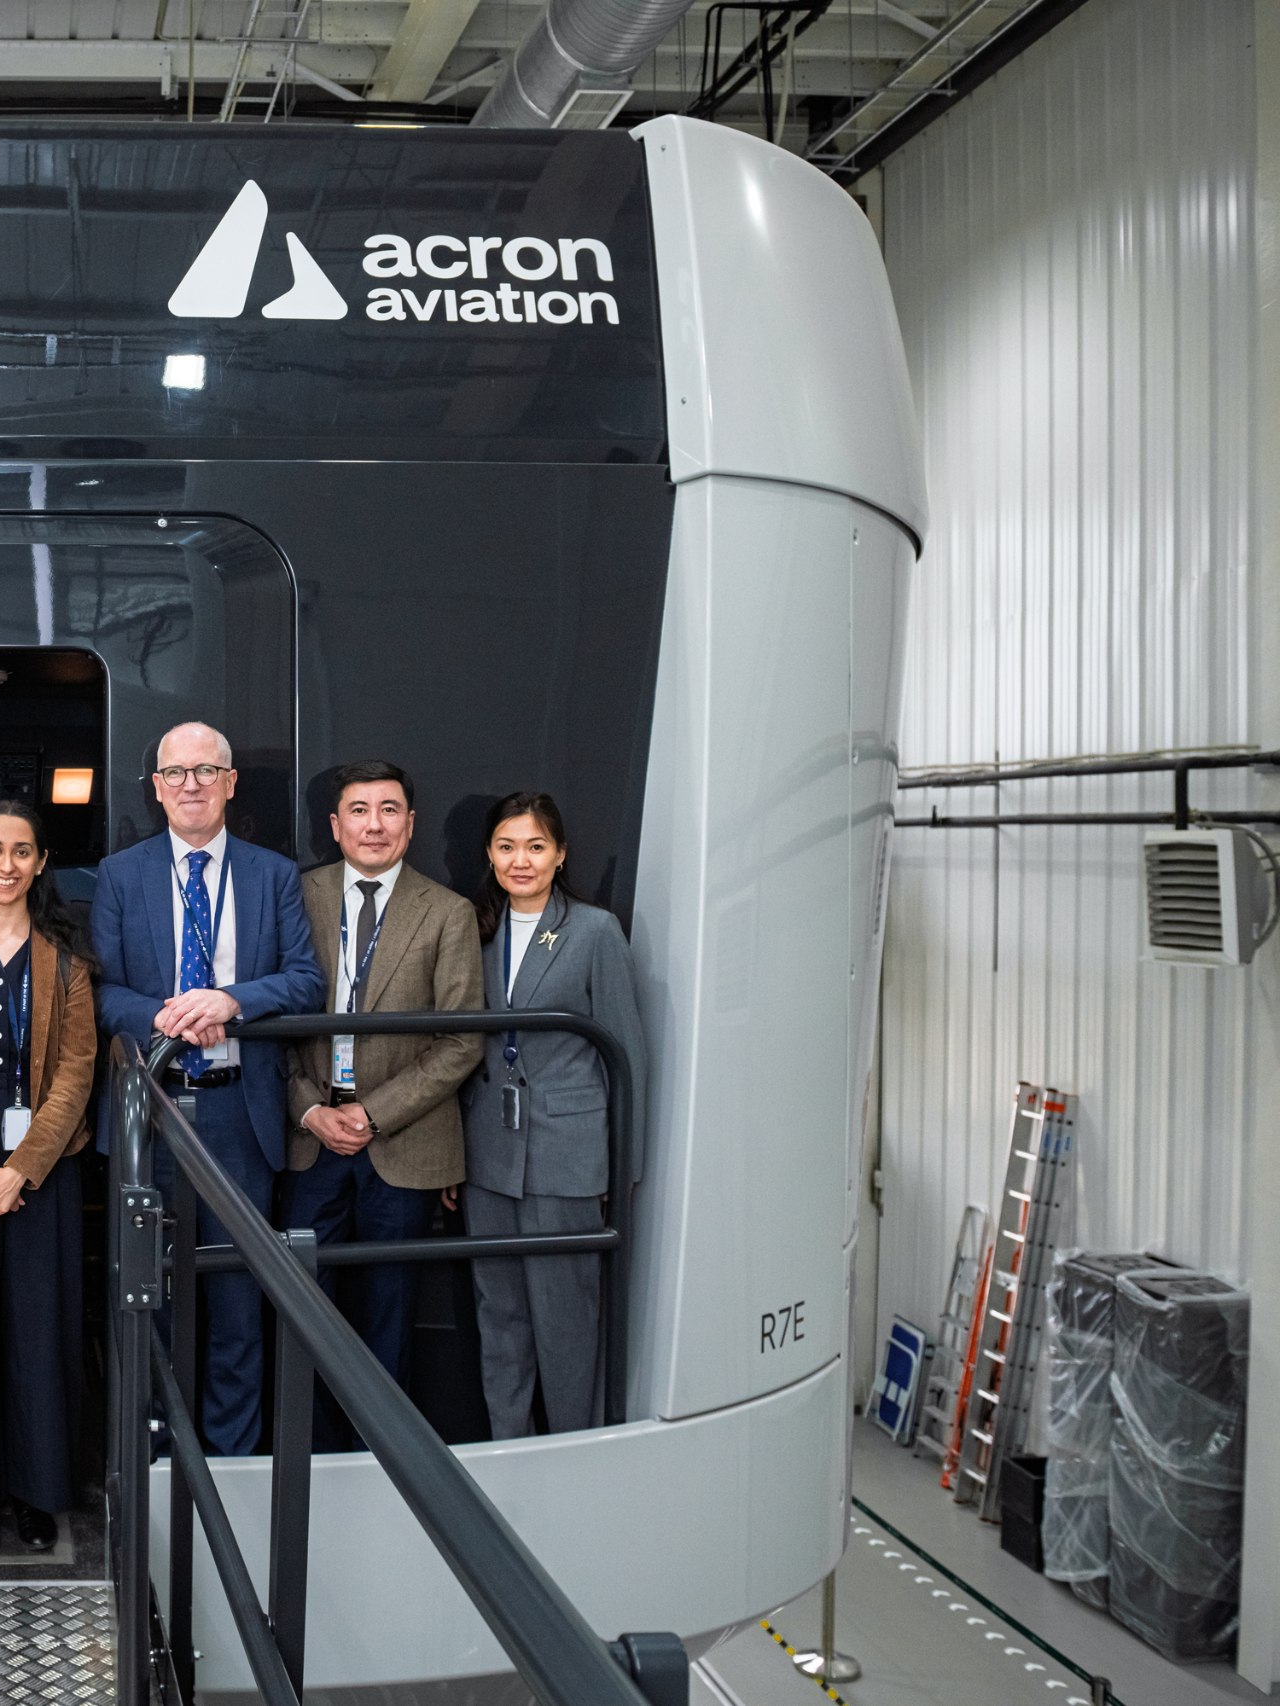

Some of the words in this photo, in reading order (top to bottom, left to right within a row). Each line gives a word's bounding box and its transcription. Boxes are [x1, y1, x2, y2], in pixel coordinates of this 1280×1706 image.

[362, 234, 614, 282] acron
[365, 283, 620, 325] aviation
[760, 1300, 805, 1354] R7E
